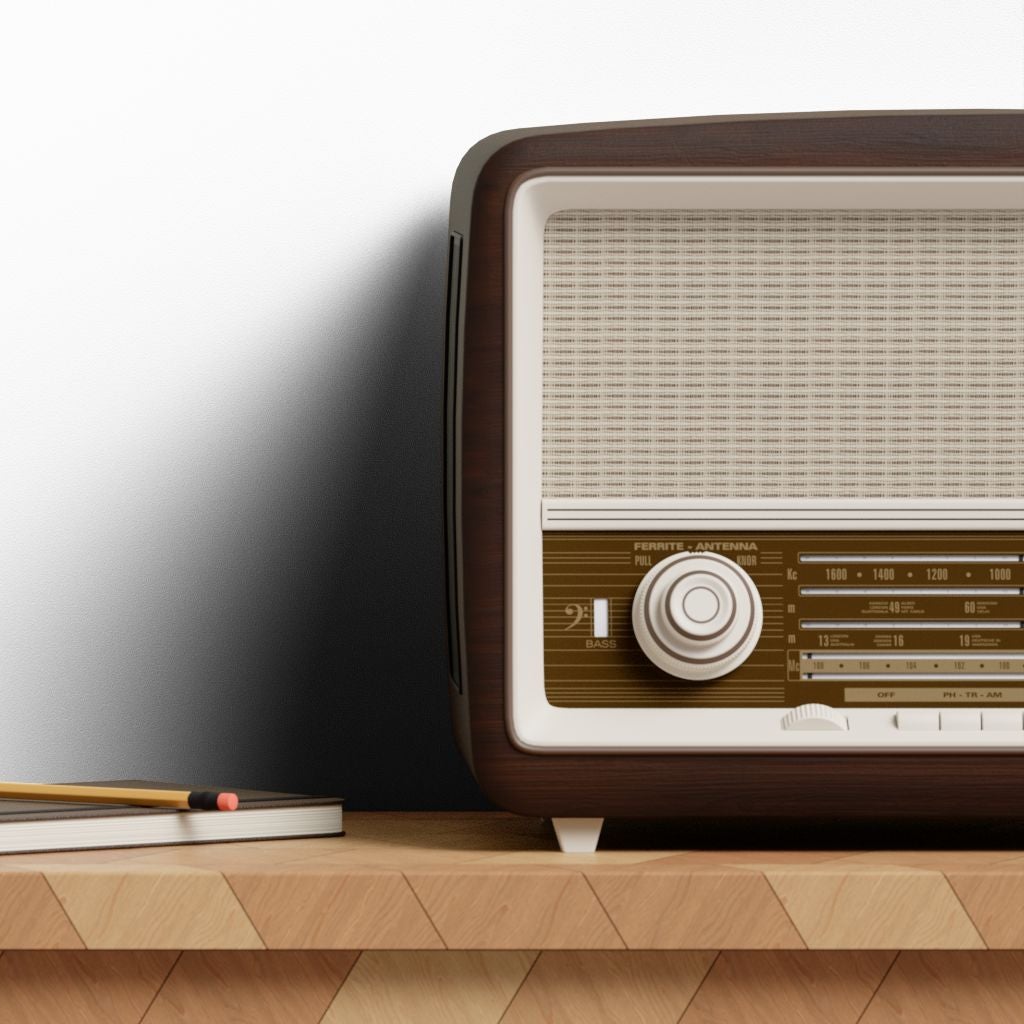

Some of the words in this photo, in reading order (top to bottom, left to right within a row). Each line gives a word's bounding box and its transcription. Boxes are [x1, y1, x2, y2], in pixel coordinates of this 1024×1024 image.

[634, 542, 684, 551] FERRITE
[695, 542, 758, 551] ANTENNA
[634, 555, 652, 566] PULL
[787, 568, 798, 580] Kc
[826, 568, 847, 580] 1600
[873, 568, 895, 580] 1400
[927, 568, 948, 580] 1200
[989, 568, 1011, 580] 1000
[889, 601, 900, 614] 49
[964, 601, 976, 614] 60
[586, 640, 617, 648] BASS
[818, 634, 829, 647] 13
[893, 634, 904, 647] 16
[959, 634, 970, 647] 19
